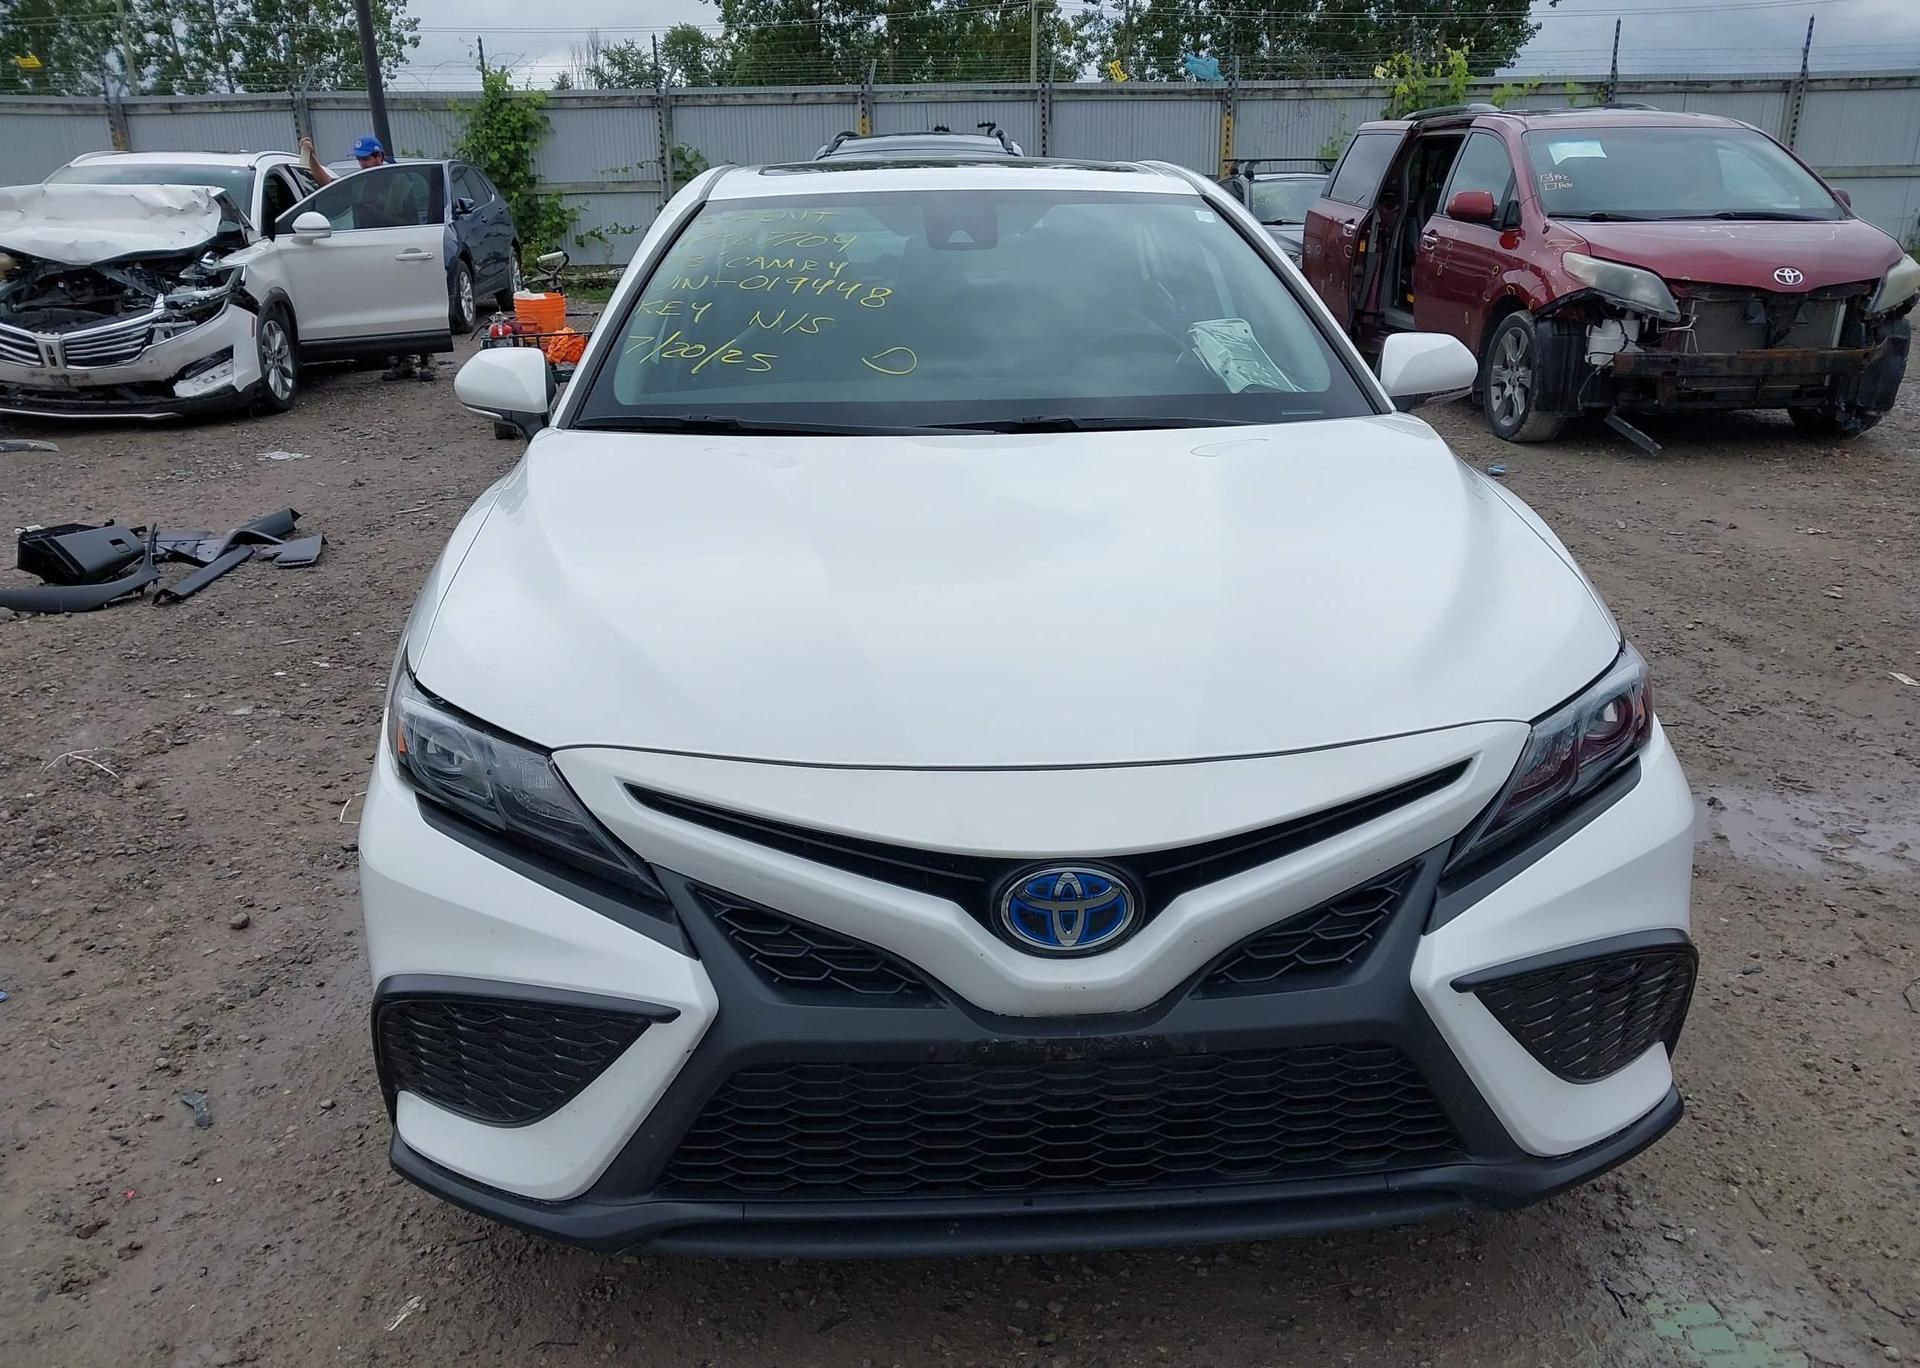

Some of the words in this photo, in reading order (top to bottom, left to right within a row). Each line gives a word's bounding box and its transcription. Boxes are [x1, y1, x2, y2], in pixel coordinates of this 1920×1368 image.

[725, 256, 849, 278] CAMRY
[633, 300, 713, 323] KEY
[749, 309, 836, 335] N/S
[626, 331, 779, 374] 7/20/25
